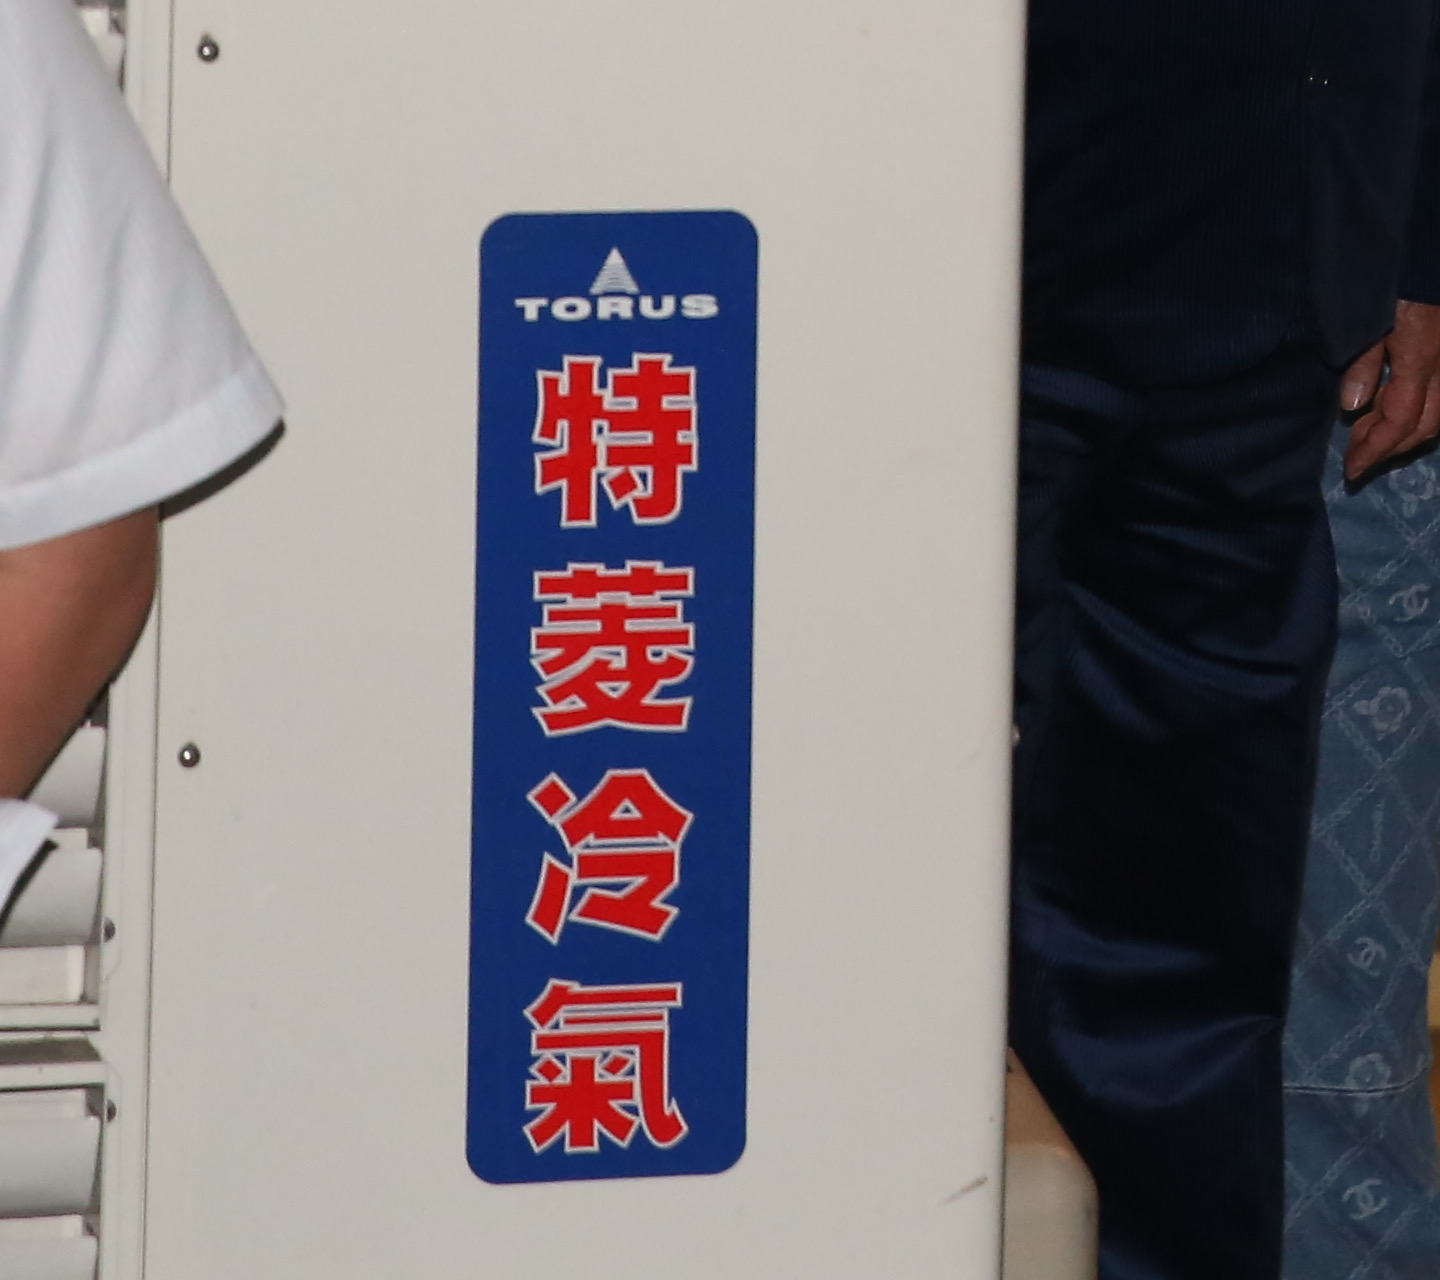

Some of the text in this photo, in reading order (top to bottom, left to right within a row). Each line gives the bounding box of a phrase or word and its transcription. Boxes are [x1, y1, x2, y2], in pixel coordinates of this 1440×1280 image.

[514, 293, 720, 323] TORUS
[525, 352, 699, 1155] 特菱冷氣
